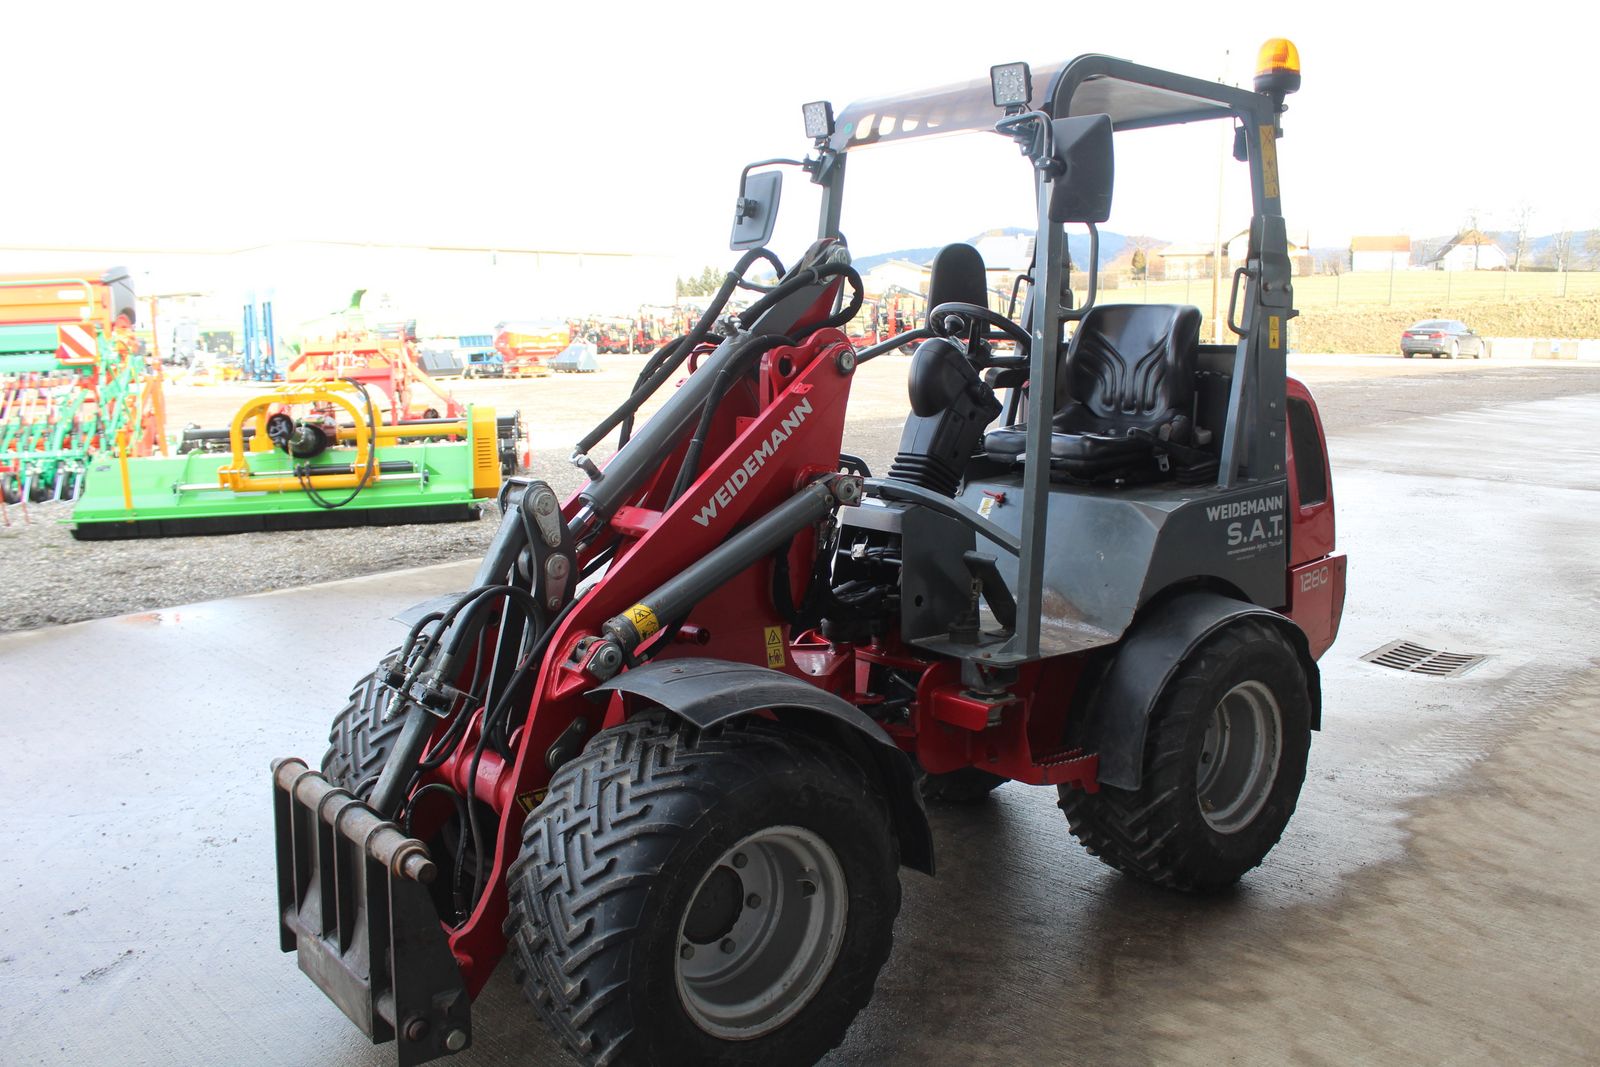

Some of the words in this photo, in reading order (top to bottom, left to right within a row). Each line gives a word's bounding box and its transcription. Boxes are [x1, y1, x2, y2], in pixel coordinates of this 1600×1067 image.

[692, 397, 813, 527] WEIDEMANN
[1206, 495, 1283, 522] WEIDEMANN
[1227, 514, 1283, 546] S.A.T.
